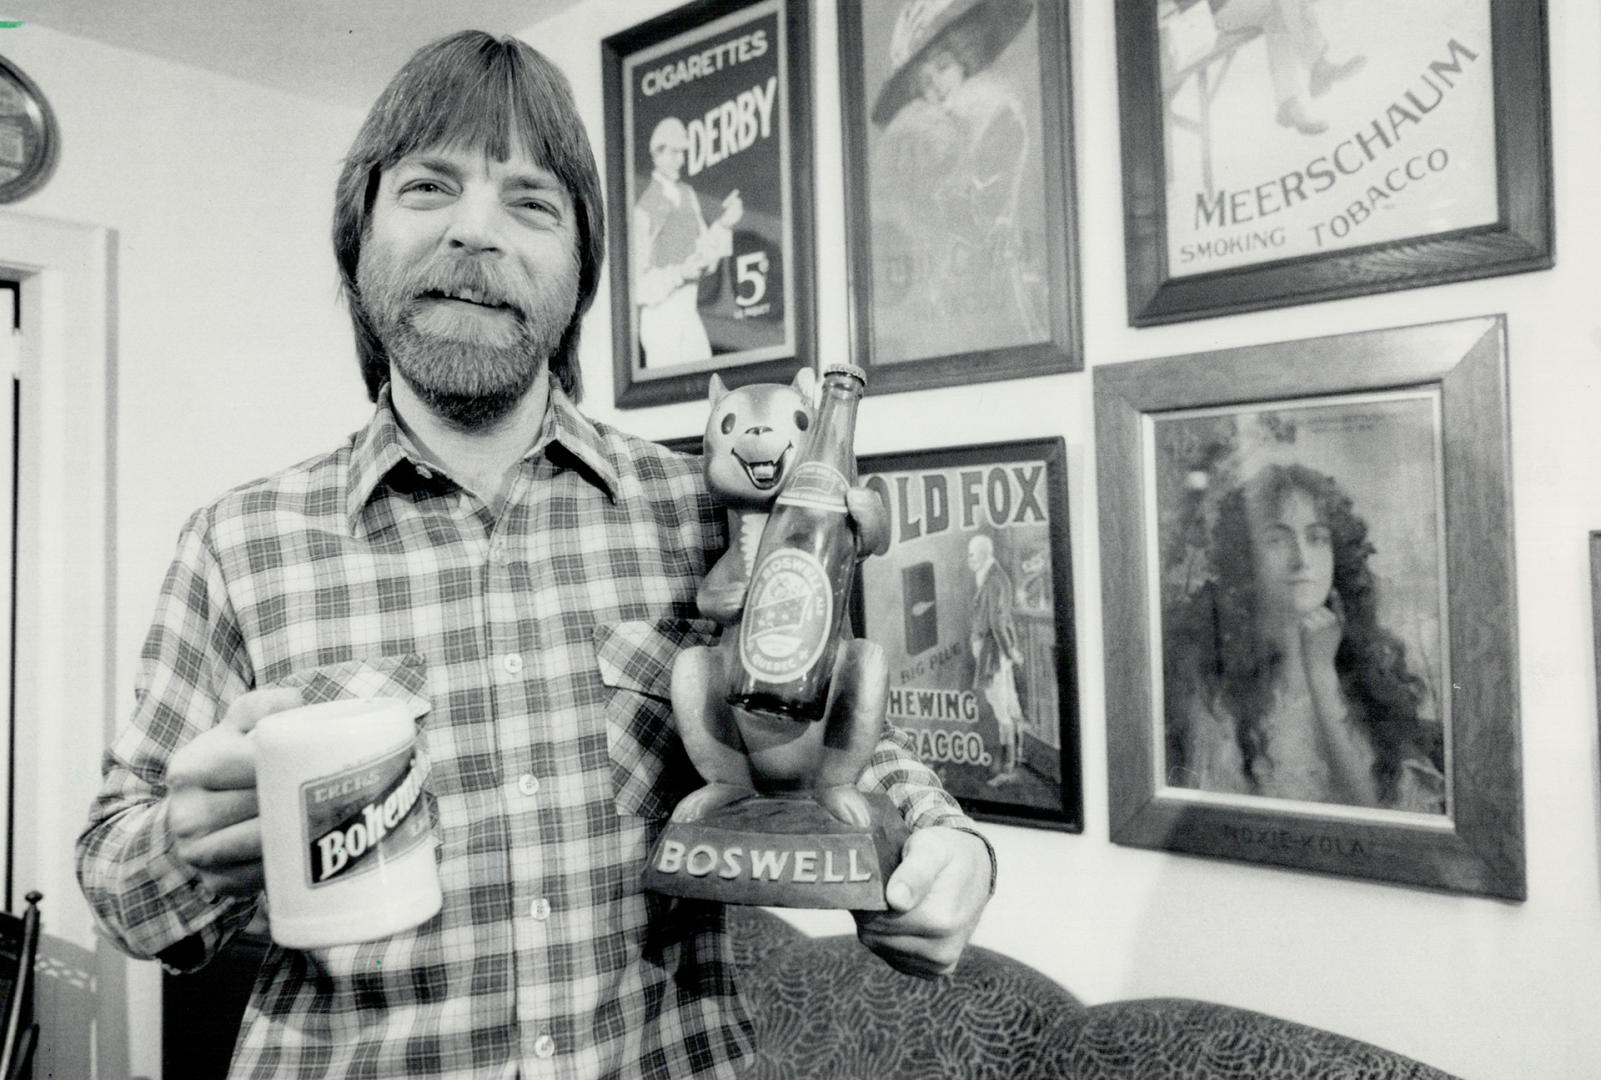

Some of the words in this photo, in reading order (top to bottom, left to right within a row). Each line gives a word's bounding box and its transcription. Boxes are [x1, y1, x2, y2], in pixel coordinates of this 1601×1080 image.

[641, 30, 768, 97] CIGARETTES
[687, 76, 777, 176] DERBY
[1194, 38, 1480, 231] MEERSCHAUM
[1180, 228, 1286, 263] SMOKING
[1310, 148, 1449, 247] TOBACCO
[959, 466, 1048, 528] FOX
[889, 690, 977, 721] HEWING
[657, 840, 871, 882] BOSWELL
